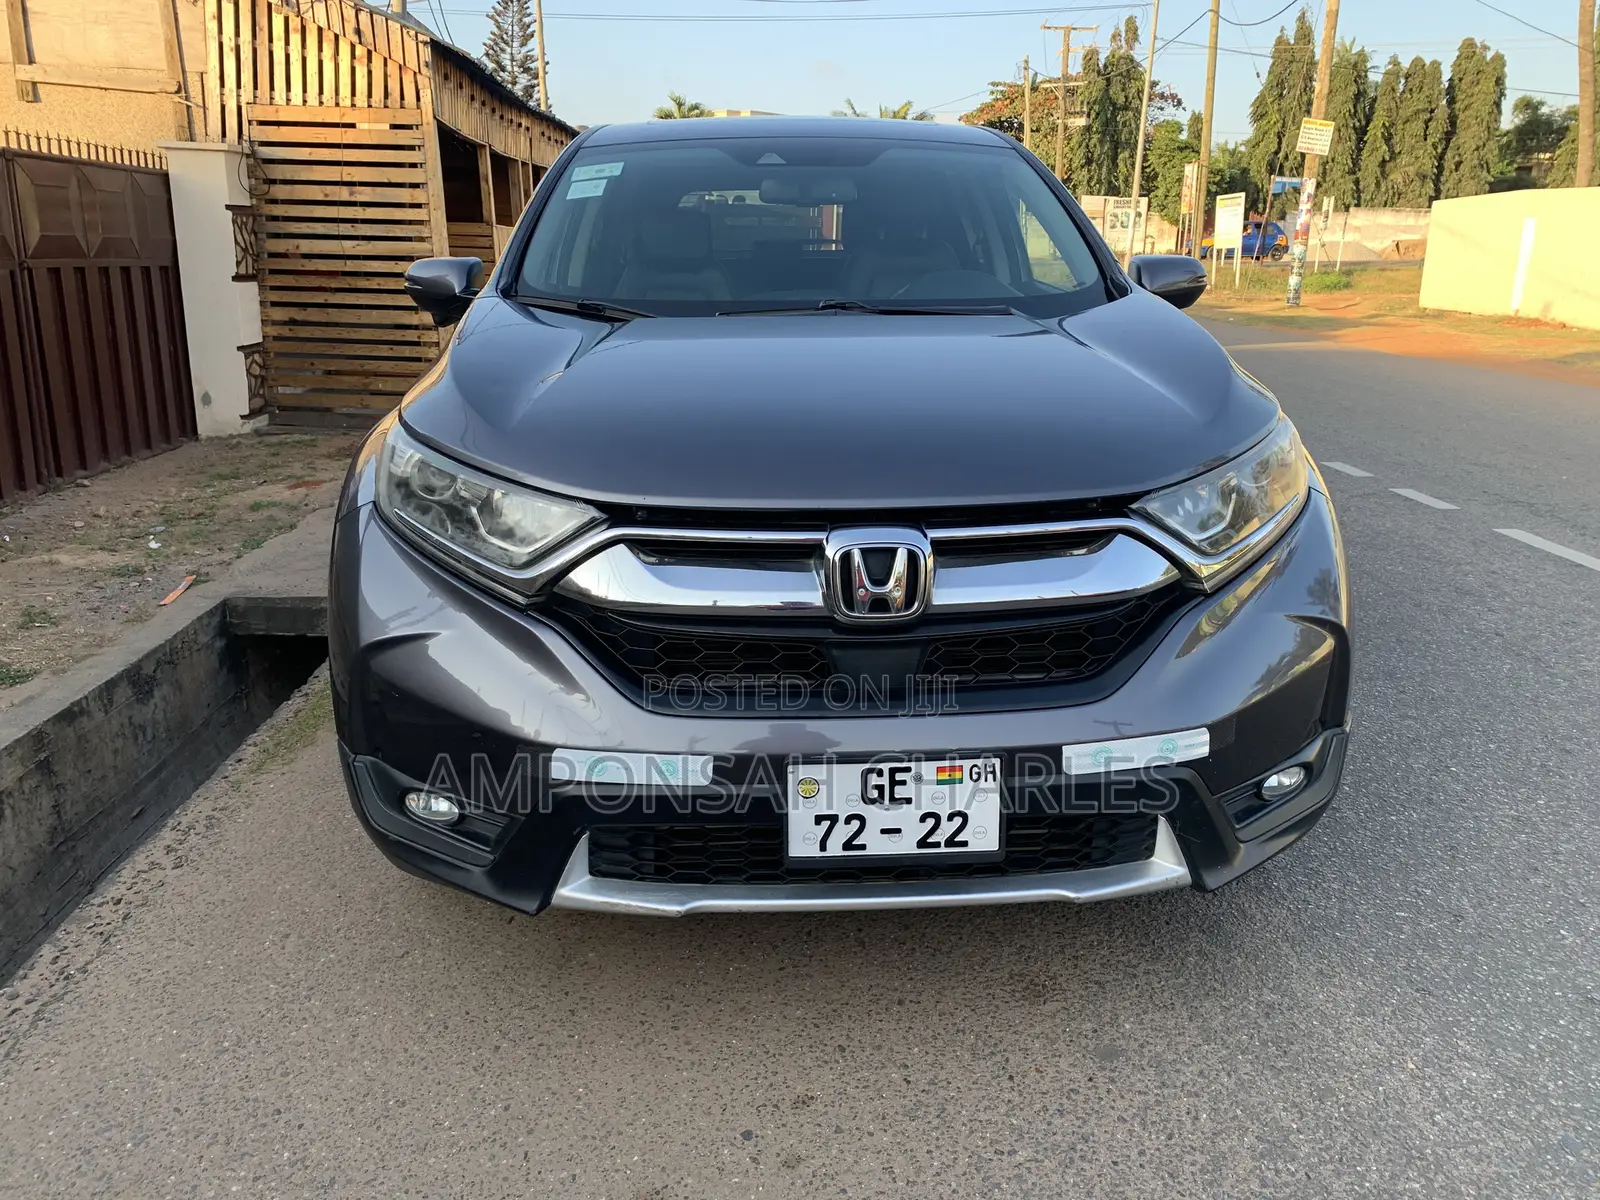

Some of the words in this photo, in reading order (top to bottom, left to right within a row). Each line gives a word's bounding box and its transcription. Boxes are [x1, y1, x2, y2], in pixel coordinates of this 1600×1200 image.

[861, 766, 913, 806] GE
[969, 763, 997, 783] GH
[814, 813, 867, 853] 72
[916, 810, 969, 849] 22
